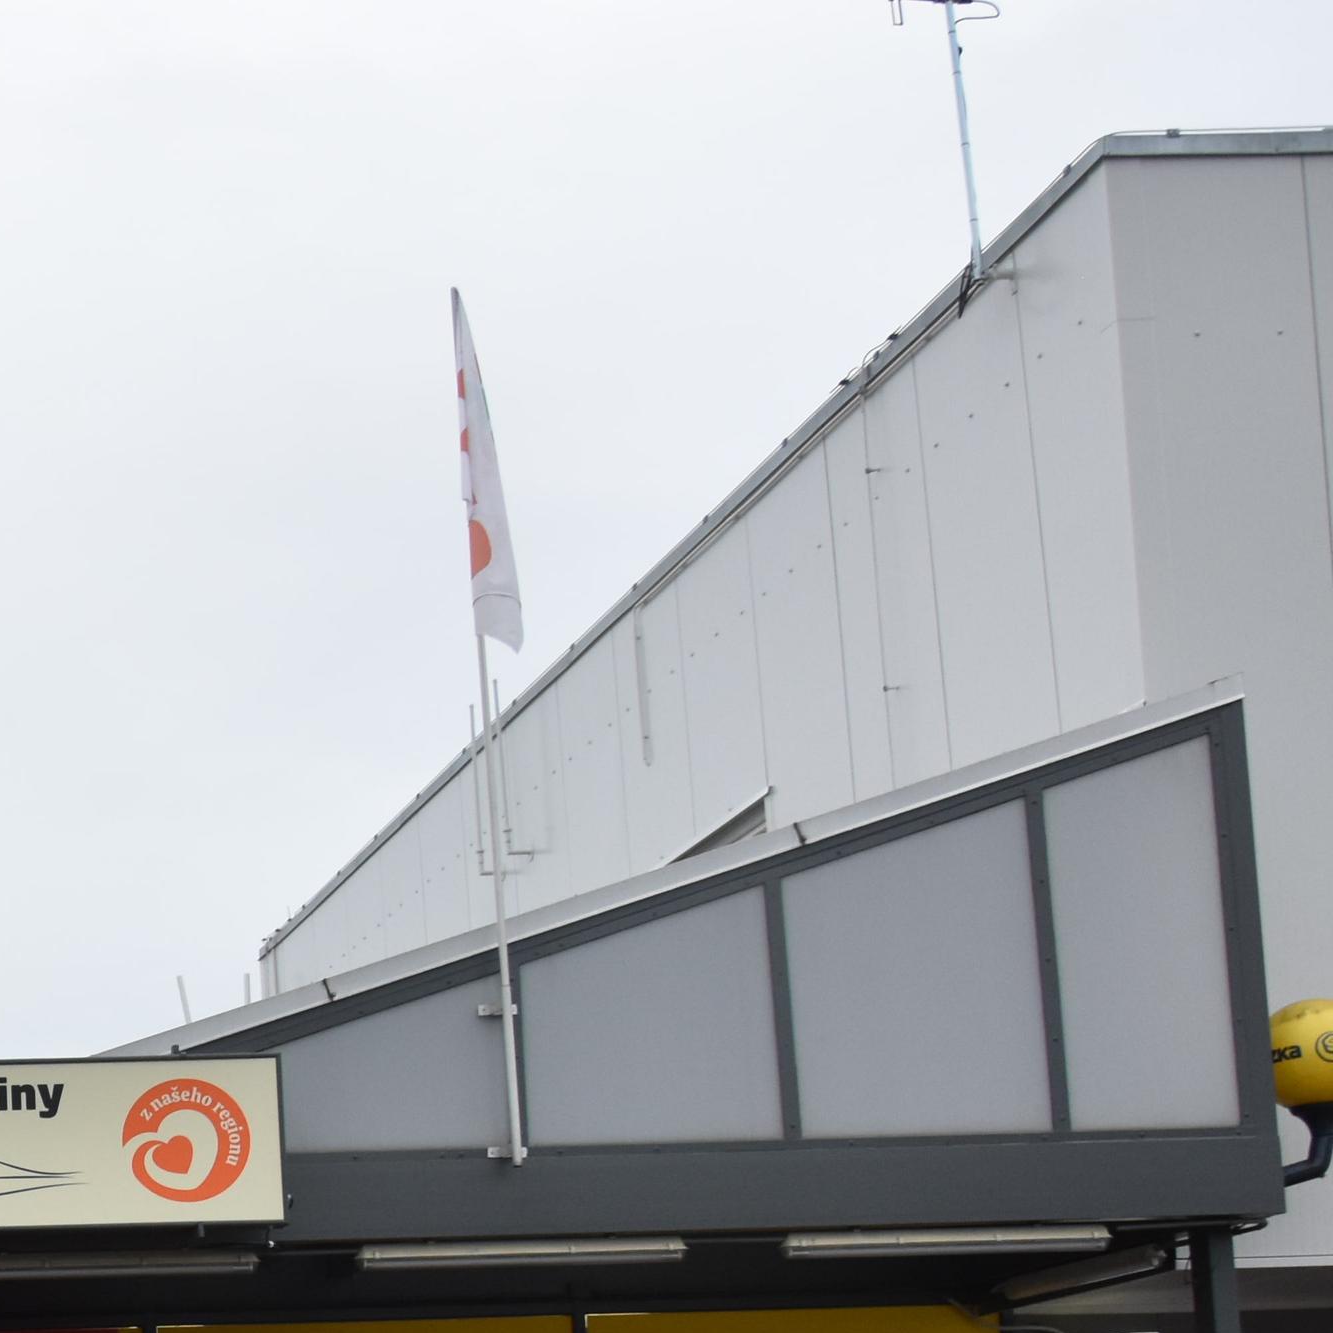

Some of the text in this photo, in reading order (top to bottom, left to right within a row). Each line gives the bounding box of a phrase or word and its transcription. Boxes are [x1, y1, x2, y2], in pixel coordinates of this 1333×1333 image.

[1271, 1045, 1301, 1063] zka
[140, 1085, 244, 1167] z našeho regionu
